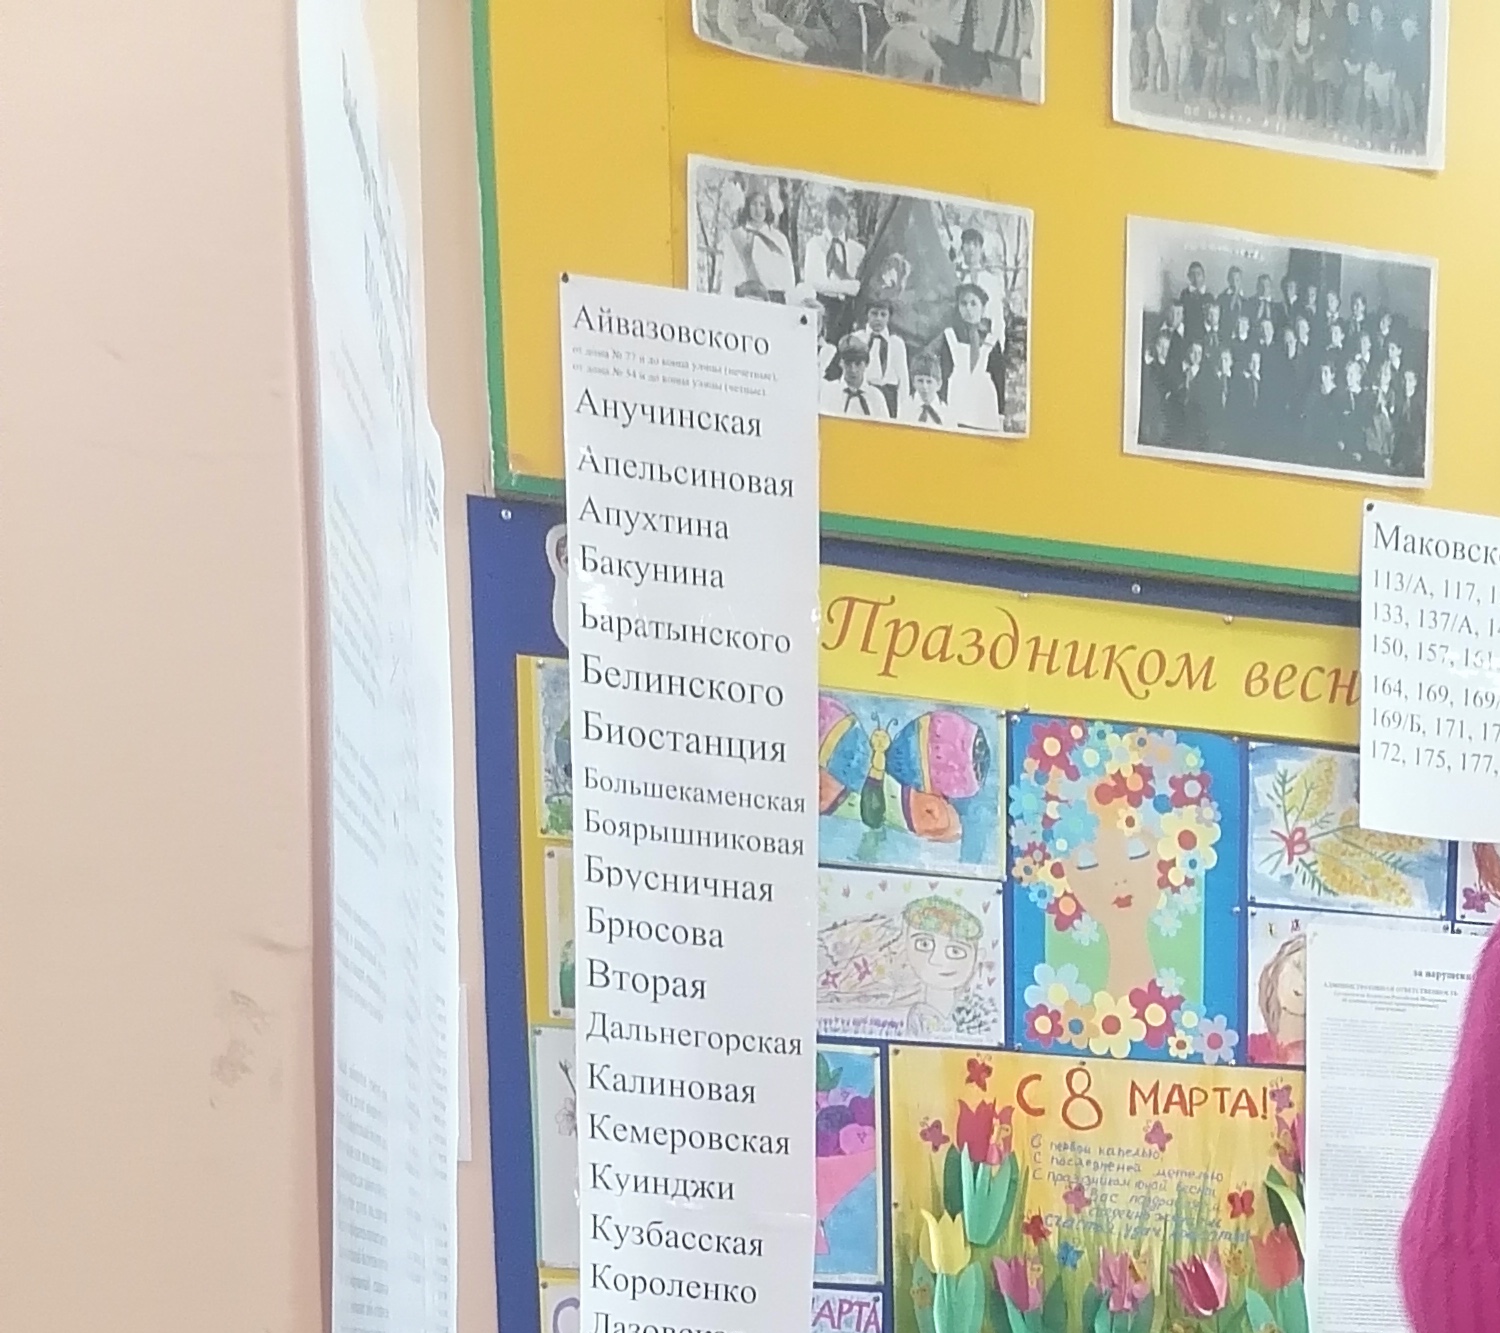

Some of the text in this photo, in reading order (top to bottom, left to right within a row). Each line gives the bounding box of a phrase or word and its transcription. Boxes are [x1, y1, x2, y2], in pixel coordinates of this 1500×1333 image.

[573, 305, 770, 358] Айвазовского
[575, 387, 763, 438] Анучинская
[576, 446, 796, 499] Апельсиновая
[579, 496, 730, 541] Апухтина
[580, 544, 725, 590] Бакунина
[580, 603, 792, 655] Баратынского
[821, 594, 1361, 708] Праздником весн
[581, 655, 785, 706] Белинского
[582, 711, 788, 764] Биостанция
[584, 767, 807, 815] Большекаменская
[585, 810, 806, 858] Боярышниковая
[585, 854, 775, 903] Брусничная
[586, 907, 725, 949] Брюсова
[586, 958, 708, 1002] Вторая
[1425, 970, 1474, 982] нарушени
[586, 1011, 803, 1057] Дальнегорская
[588, 1063, 757, 1104] Калиновая
[1016, 1066, 1269, 1132] С 8 МАРТА!
[588, 1113, 791, 1156] Кемеровская
[590, 1163, 736, 1202] Куинджи
[590, 1213, 765, 1258] Кузбасская
[590, 1264, 758, 1305] Короленко
